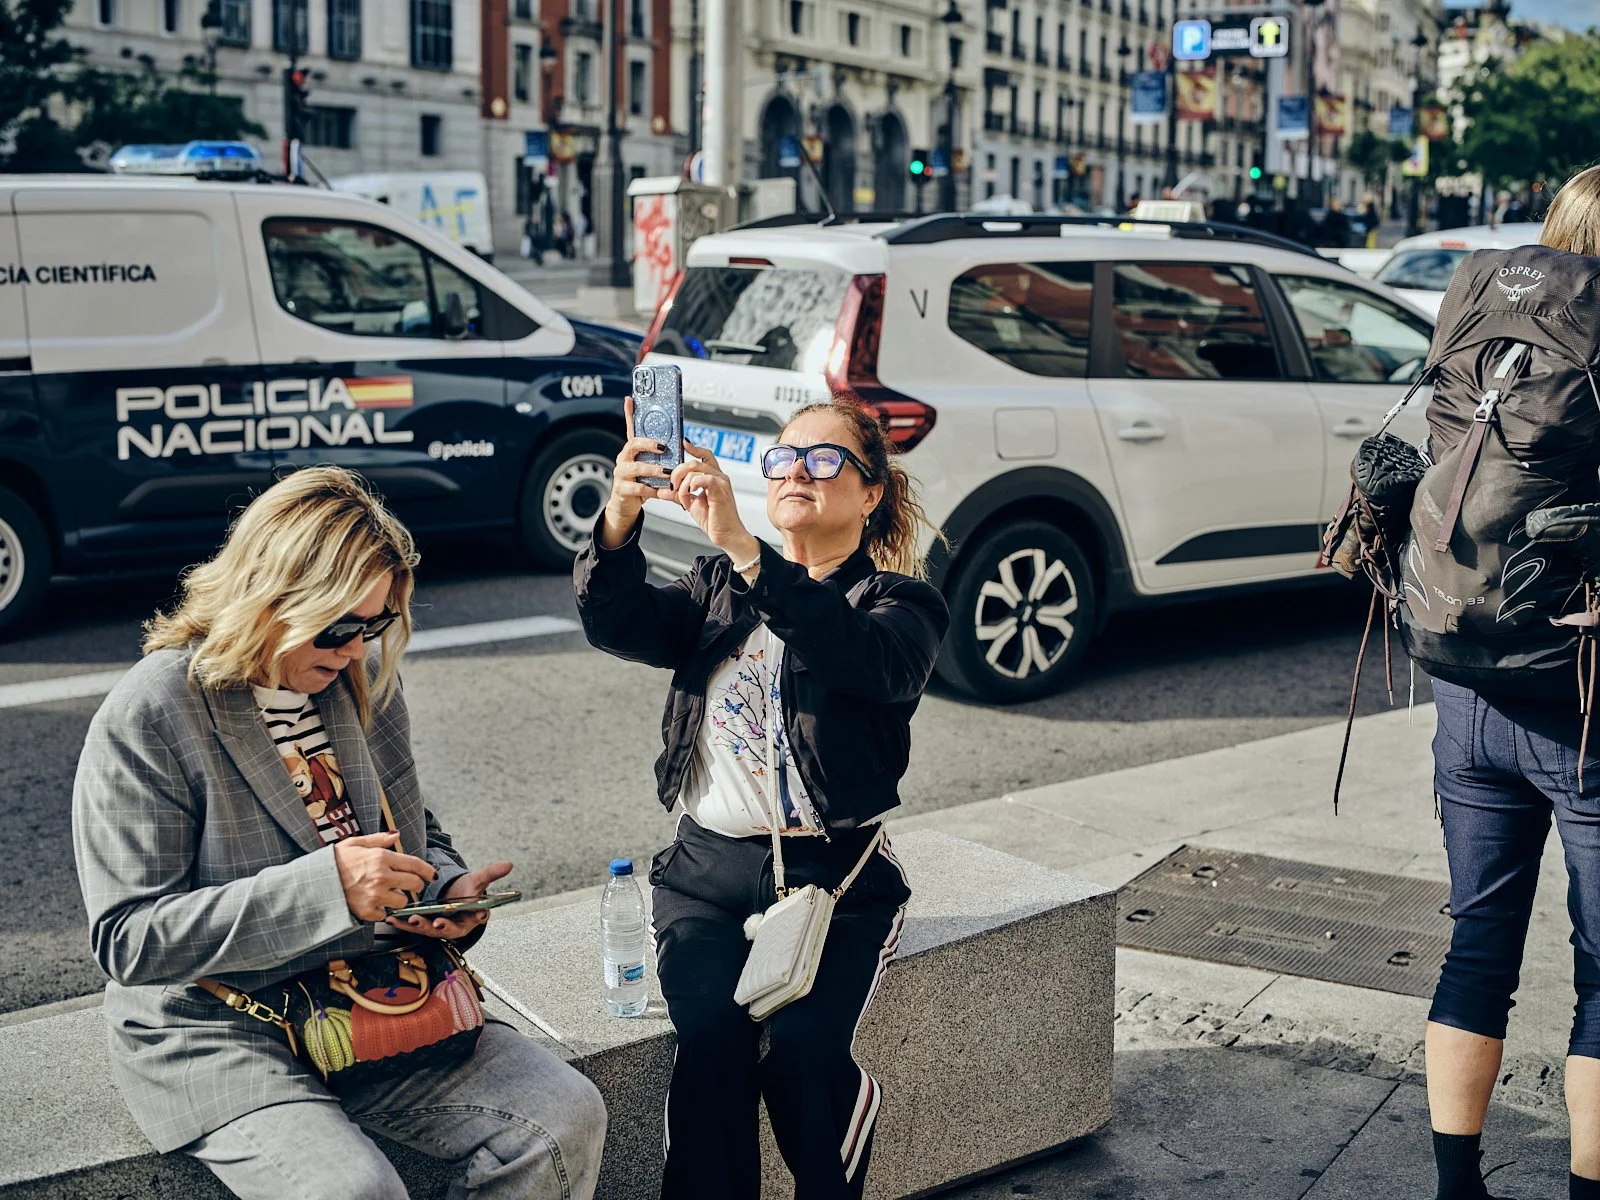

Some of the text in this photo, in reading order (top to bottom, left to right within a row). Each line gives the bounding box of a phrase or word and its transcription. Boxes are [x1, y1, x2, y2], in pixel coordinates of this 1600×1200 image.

[1182, 26, 1202, 54] P
[35, 262, 156, 284] CIENTÍFICA
[1499, 266, 1545, 281] OSPREY
[116, 377, 357, 422] POLICIA
[117, 412, 414, 460] NACIONAL
[428, 440, 494, 460] @policia
[1467, 597, 1485, 605] 33
